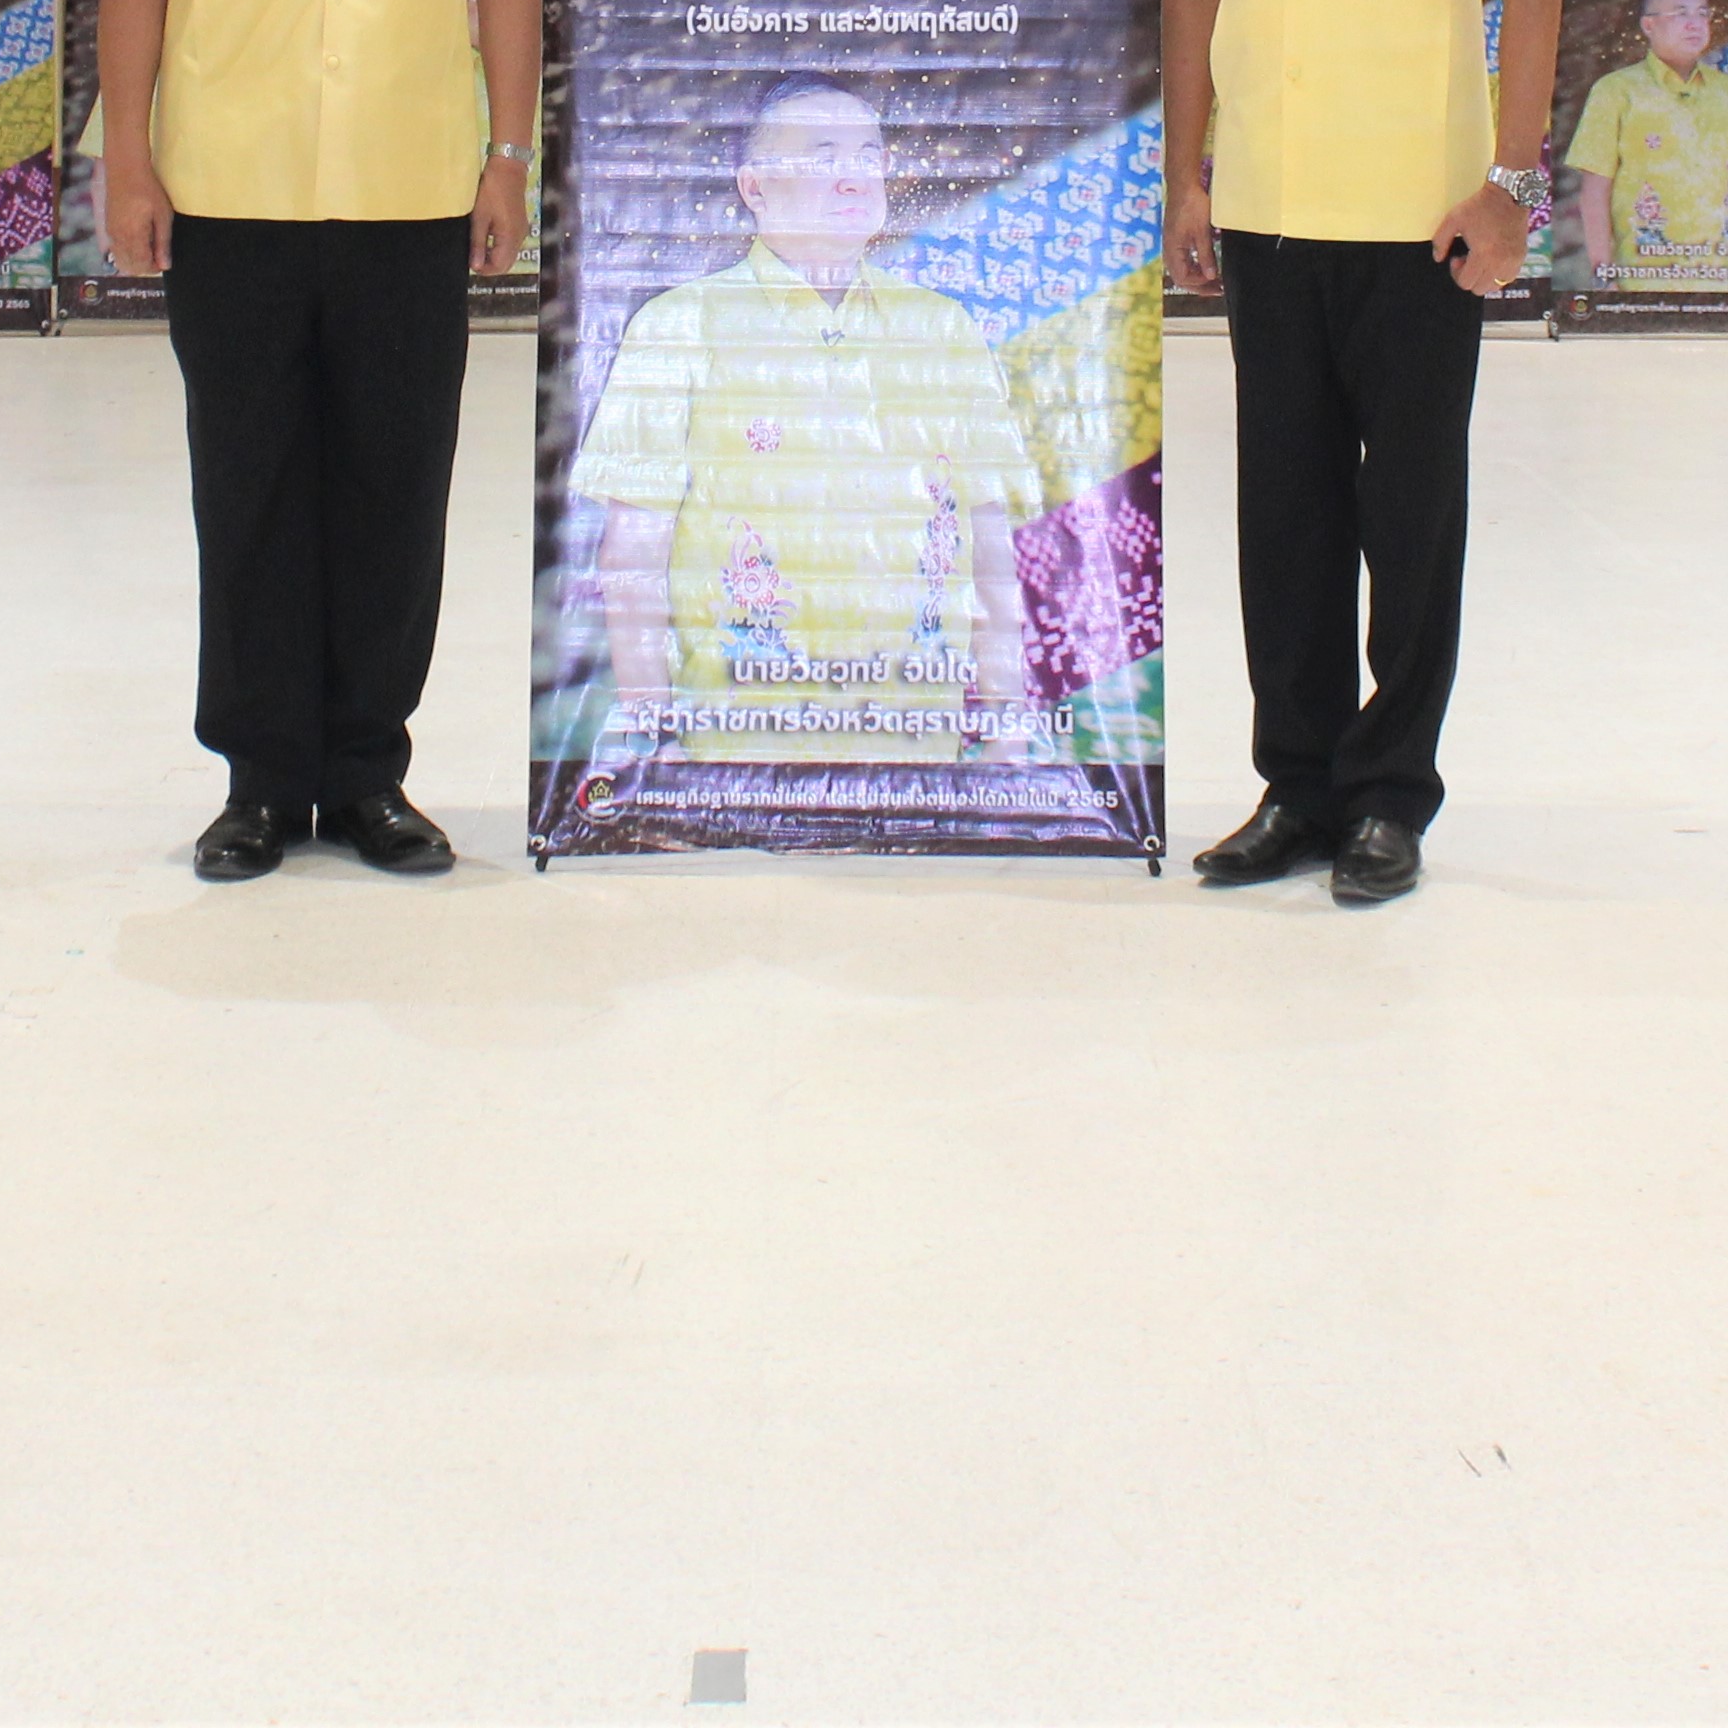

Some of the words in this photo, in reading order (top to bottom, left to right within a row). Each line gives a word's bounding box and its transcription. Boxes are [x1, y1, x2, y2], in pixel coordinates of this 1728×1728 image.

[686, 4, 809, 35] (วันอังคาร
[820, 4, 1018, 39] และวันพฤหัสบดี)
[733, 650, 891, 691] นายวิชวุทย์
[637, 700, 1073, 740] ผู้ว่าราชการจังหวัดสุราษฎร์ธานี
[1065, 790, 1119, 809] 2565
